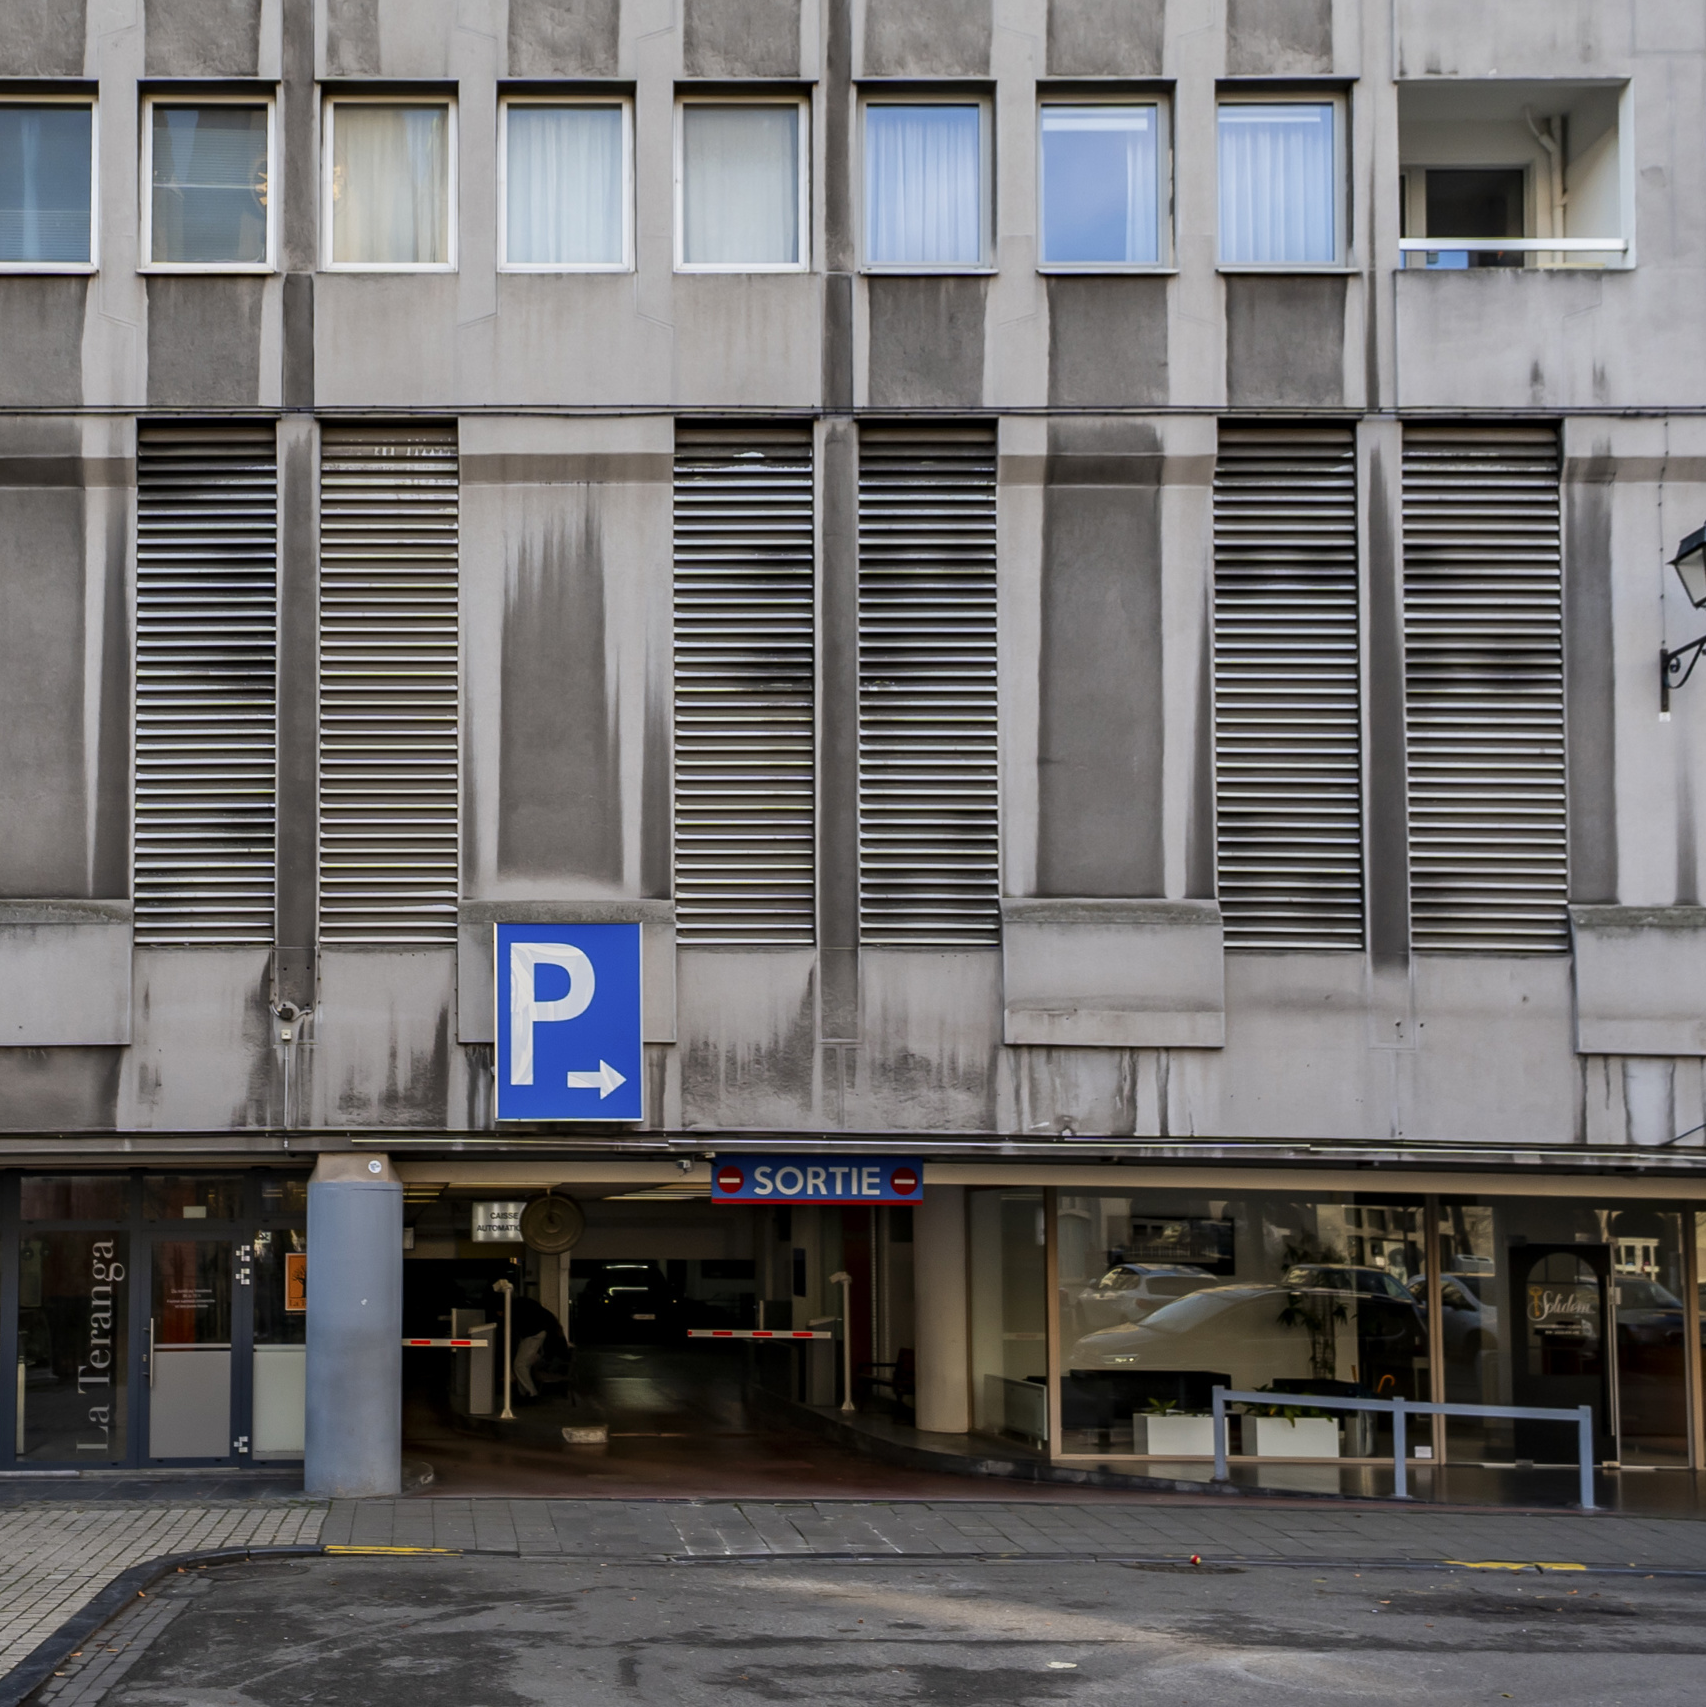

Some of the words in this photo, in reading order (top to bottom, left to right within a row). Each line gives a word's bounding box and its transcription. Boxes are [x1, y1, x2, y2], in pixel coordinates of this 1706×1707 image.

[509, 941, 596, 1086] P
[752, 1165, 882, 1197] SORTIE
[476, 1224, 521, 1232] AUTOMATI
[489, 1212, 519, 1220] CAISSE
[78, 1238, 126, 1395] Teranga
[76, 1404, 110, 1454] La
